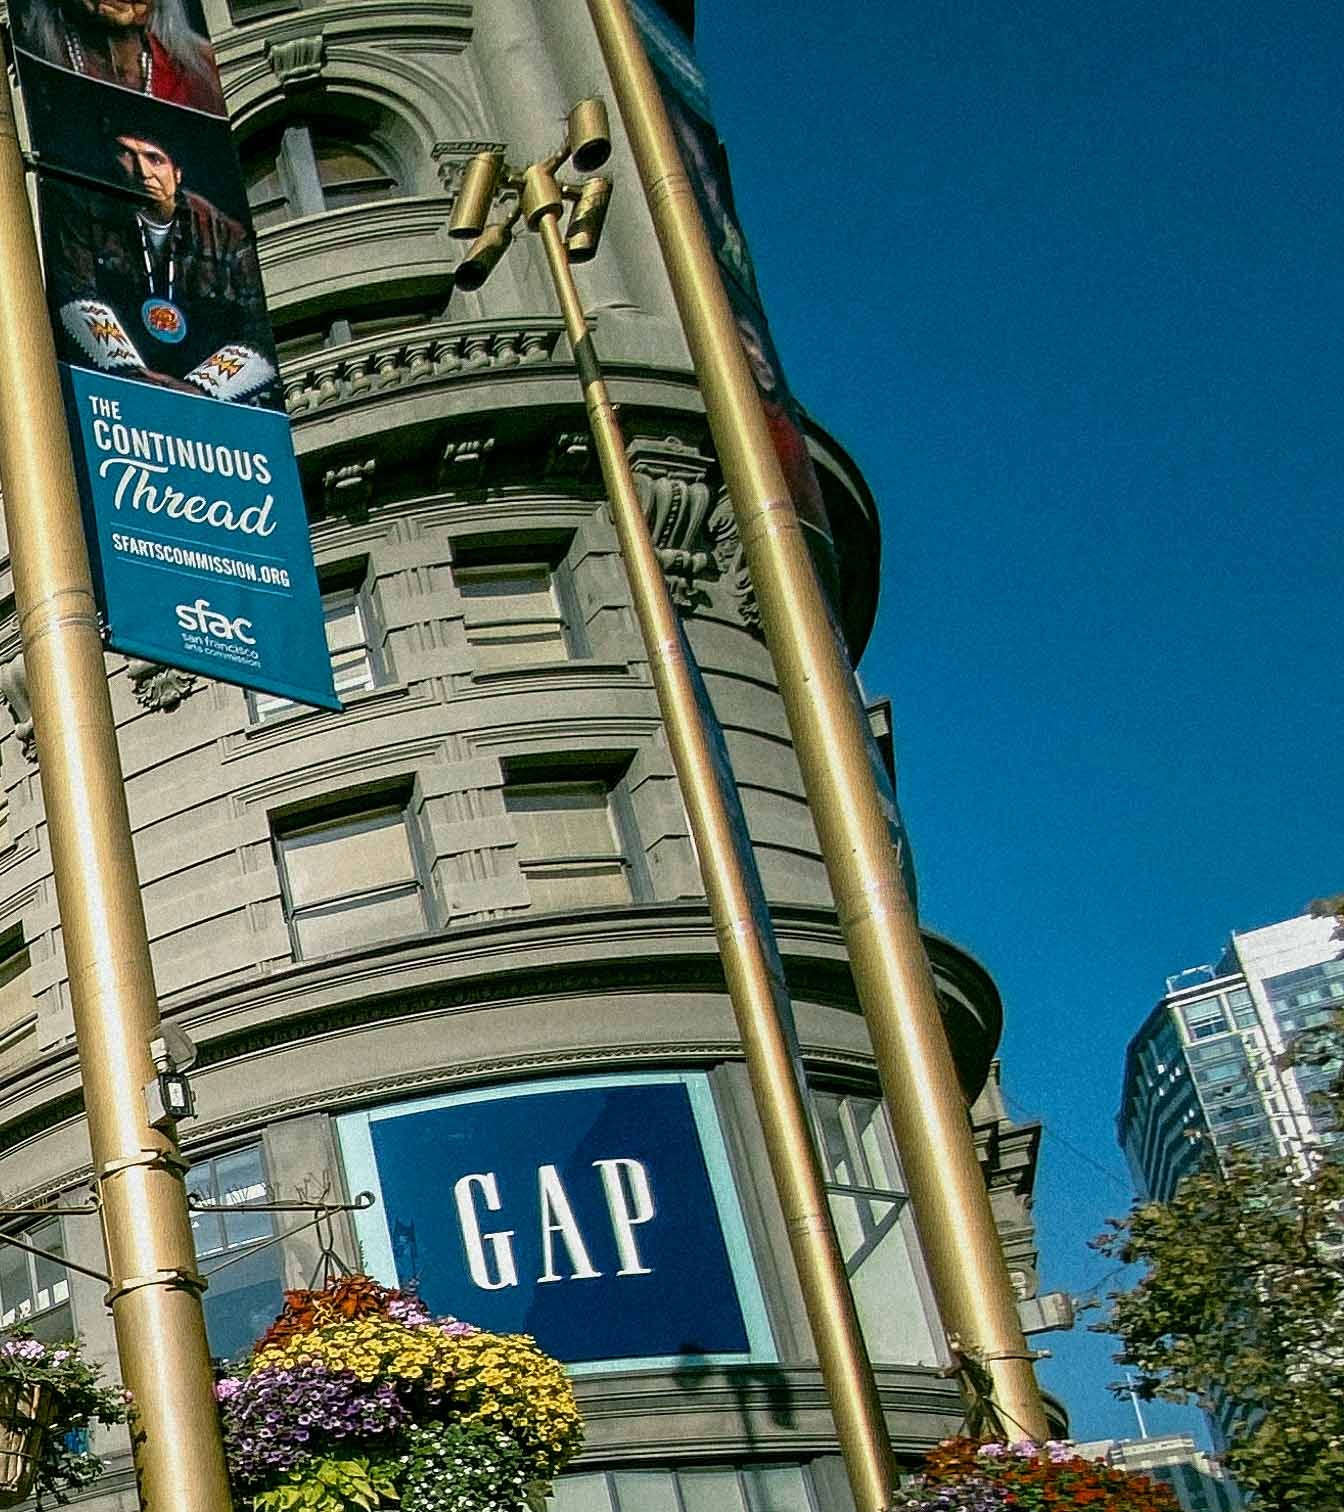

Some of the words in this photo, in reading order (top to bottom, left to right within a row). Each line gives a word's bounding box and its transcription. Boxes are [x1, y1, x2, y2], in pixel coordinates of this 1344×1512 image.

[88, 395, 122, 421] THE
[92, 418, 272, 485] CONTINUOUS
[99, 457, 277, 537] Thread
[111, 533, 291, 588] SFARTSCOMMISSION.ORG
[175, 599, 257, 645] sfac
[452, 1157, 656, 1291] GAP
